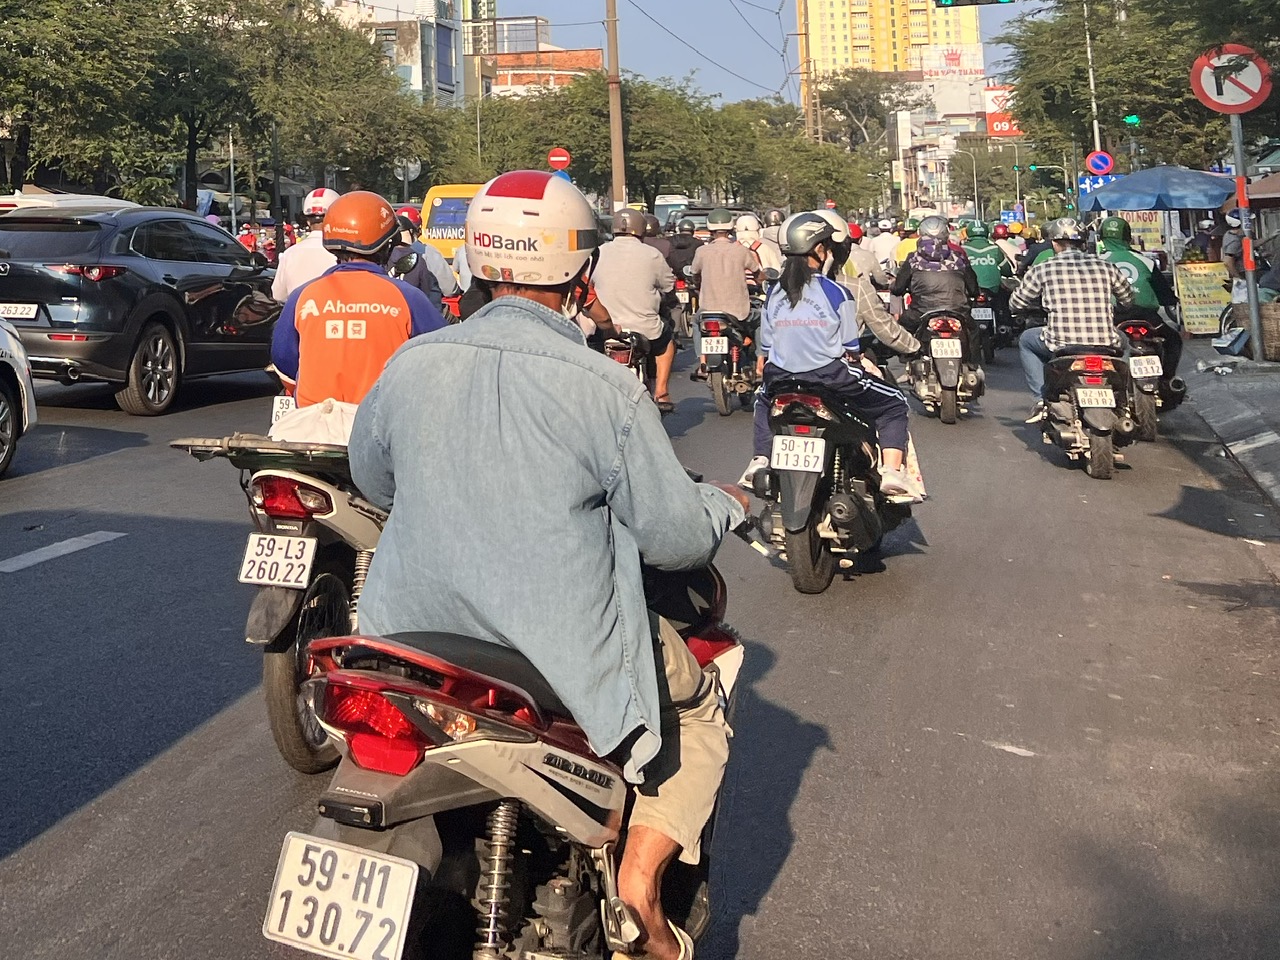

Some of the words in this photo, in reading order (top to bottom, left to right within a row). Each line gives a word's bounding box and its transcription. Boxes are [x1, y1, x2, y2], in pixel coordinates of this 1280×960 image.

[993, 122, 1009, 131] 09
[474, 232, 538, 251] HDBank
[968, 254, 995, 265] Grab
[323, 300, 400, 317] Ahamove
[781, 440, 815, 453] 50-Y1
[776, 453, 819, 468] 113.67
[255, 537, 306, 560] 59-L3
[244, 560, 306, 584] 260.22
[335, 786, 378, 797] HONDA
[298, 844, 391, 909] 59-H1
[278, 890, 396, 960] 130.72
